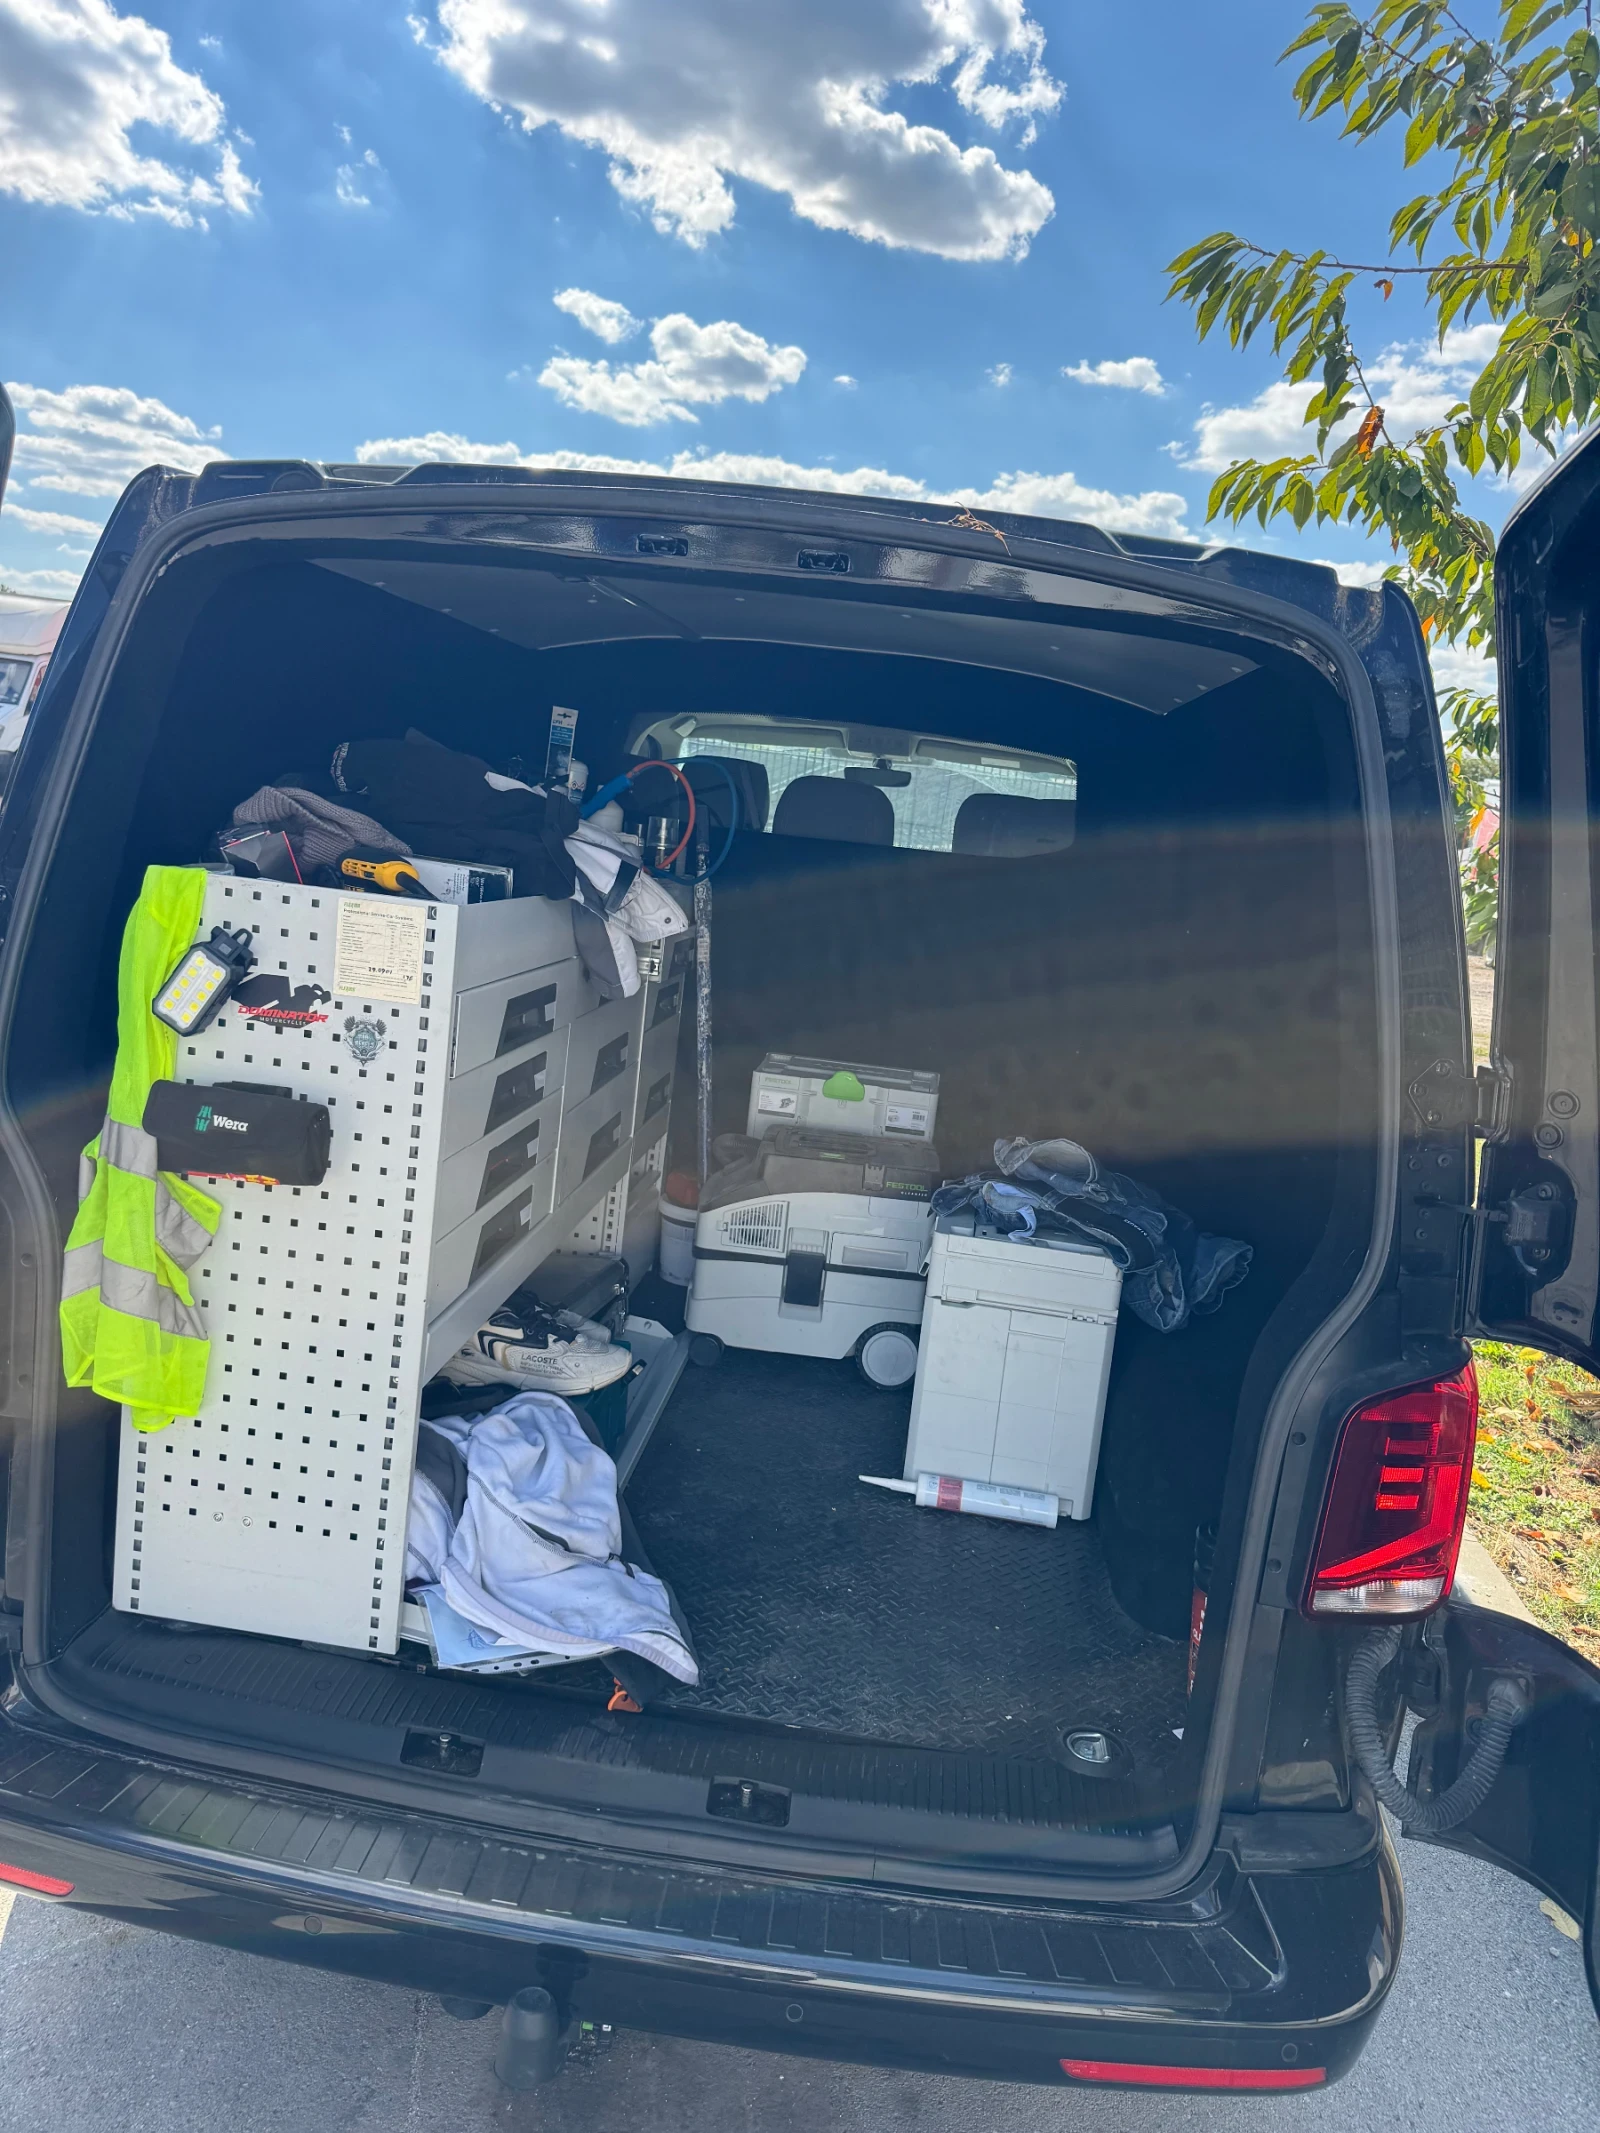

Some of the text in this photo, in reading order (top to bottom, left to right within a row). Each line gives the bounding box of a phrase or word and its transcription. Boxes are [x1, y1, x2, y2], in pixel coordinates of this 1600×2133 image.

[237, 1005, 329, 1023] DOMINATOR
[259, 1016, 307, 1026] MOTORCYCLES
[213, 1114, 249, 1132] Wera
[885, 1181, 928, 1192] FESTOOL
[521, 1353, 558, 1365] LACOSTE
